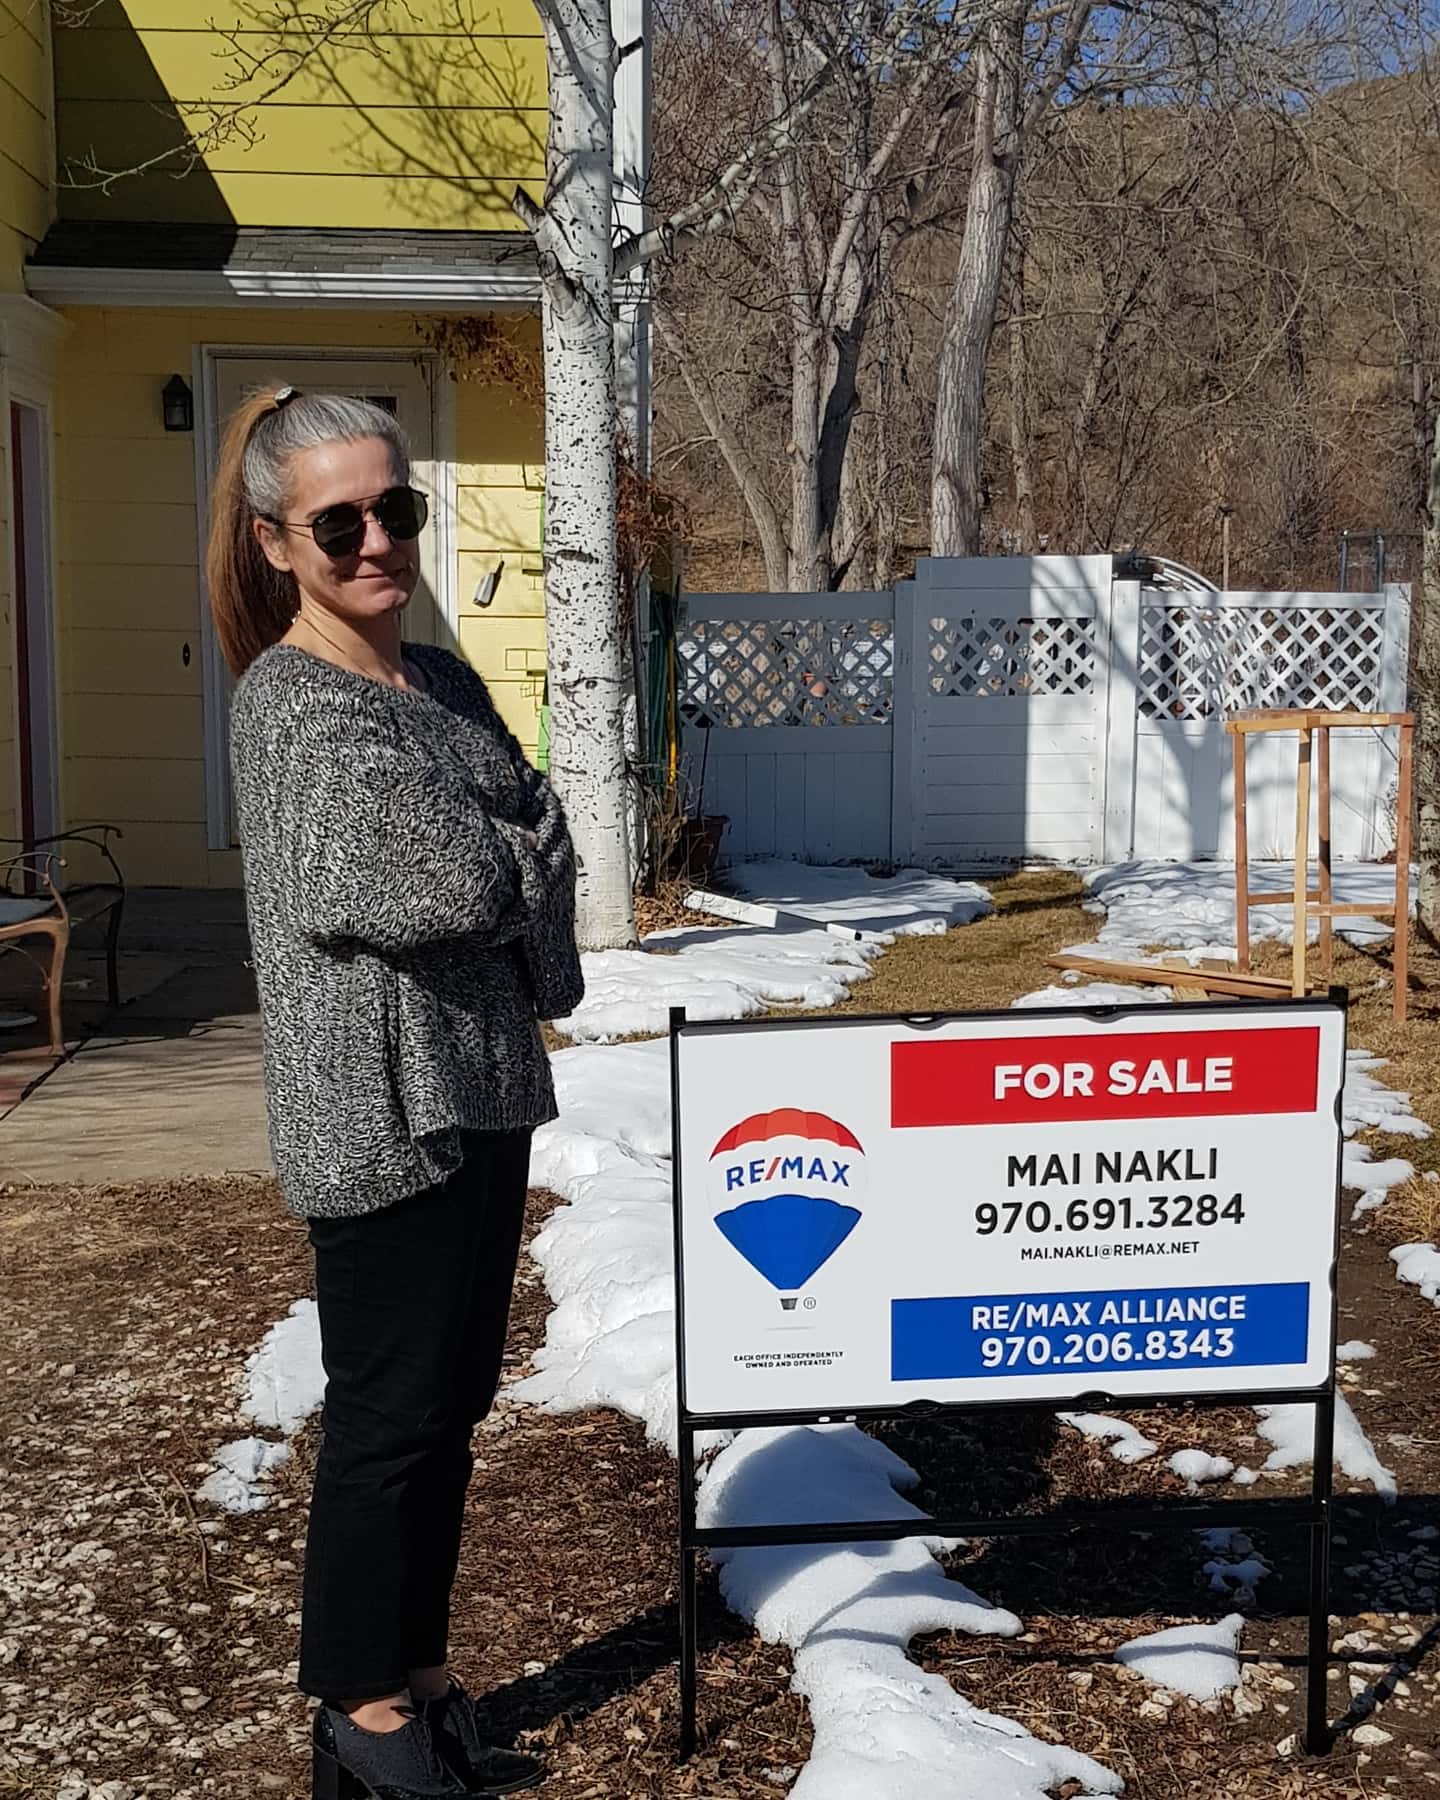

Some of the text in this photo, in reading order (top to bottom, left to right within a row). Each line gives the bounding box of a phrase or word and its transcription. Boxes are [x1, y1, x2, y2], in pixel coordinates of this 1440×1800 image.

[994, 1057, 1234, 1100] FOR SALE
[726, 1156, 850, 1191] RE/MAX
[1007, 1147, 1218, 1187] MAI NAKLI
[975, 1193, 1245, 1235] 970.691.3284
[1020, 1241, 1200, 1260] MAI.NAKLI@REMAX.NET
[972, 1296, 1247, 1332] RE/MAX ALLIANCE
[733, 1351, 844, 1362] EACH OFFICE INDEPENDENTLY
[745, 1361, 774, 1369] OWNED
[775, 1360, 792, 1368] AND
[981, 1328, 1235, 1368] 970.206.8343
